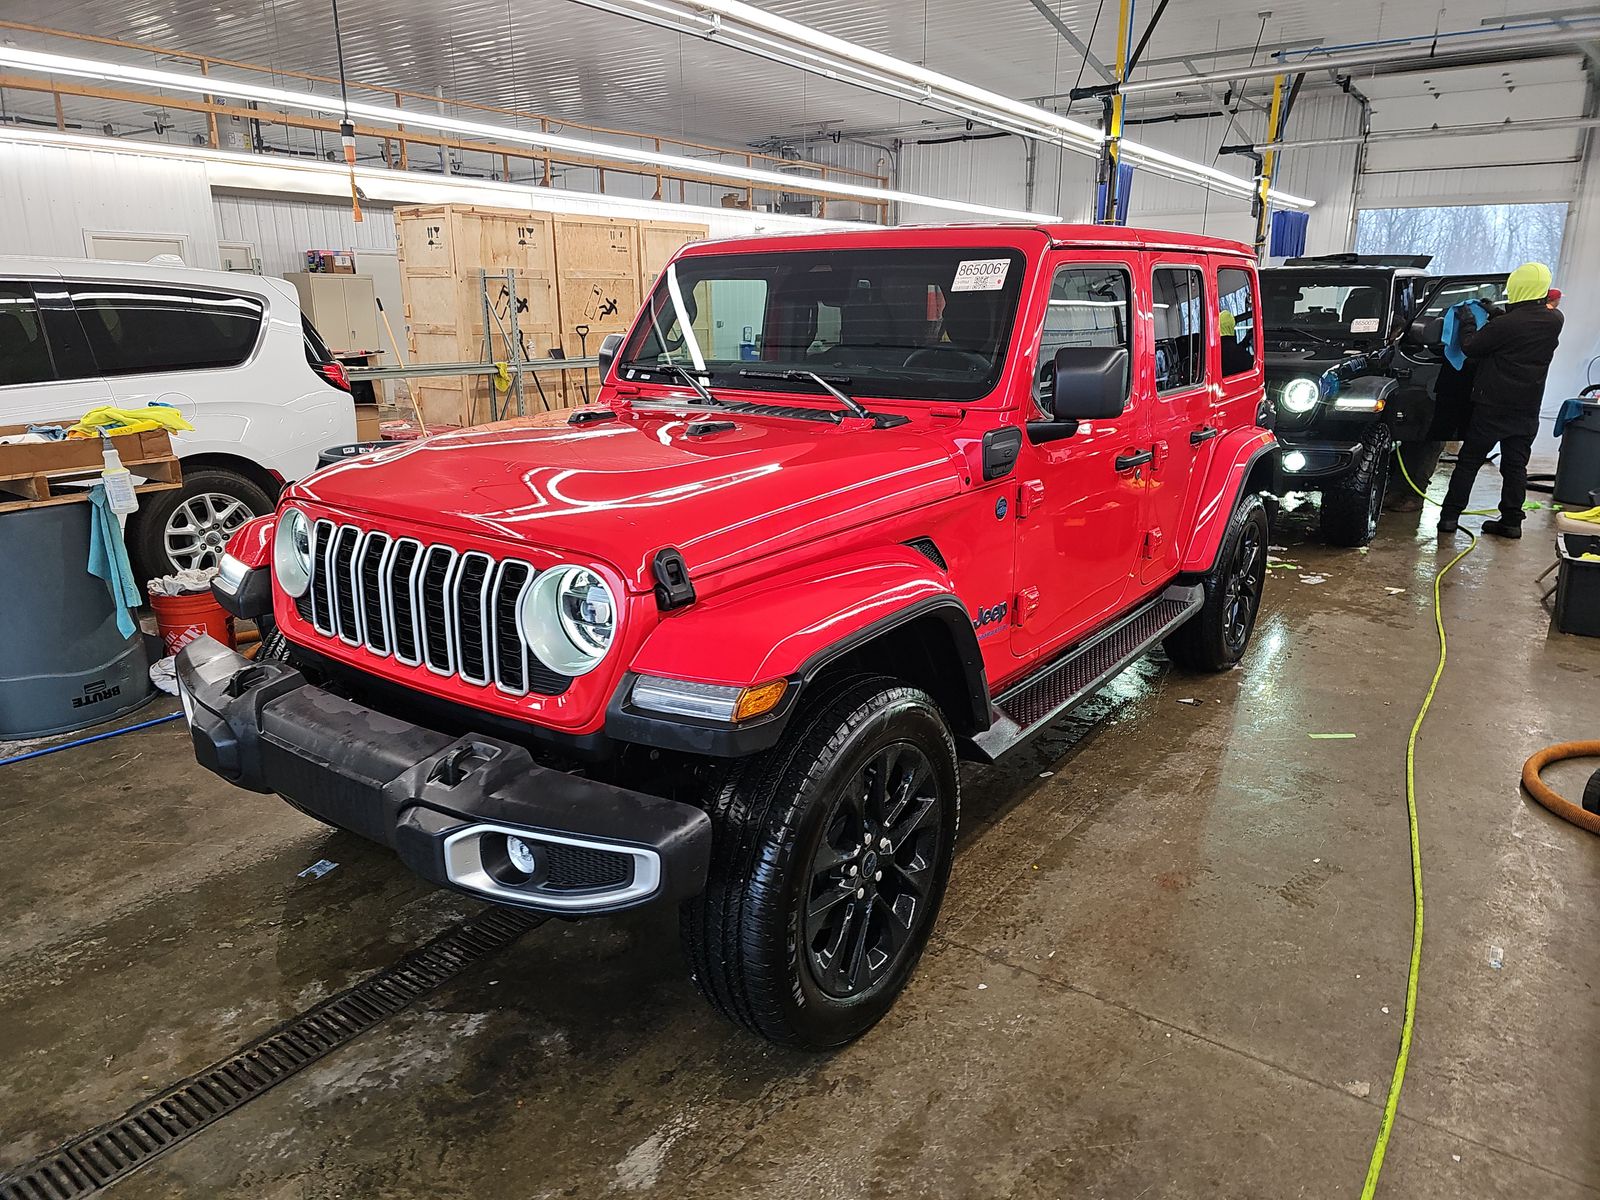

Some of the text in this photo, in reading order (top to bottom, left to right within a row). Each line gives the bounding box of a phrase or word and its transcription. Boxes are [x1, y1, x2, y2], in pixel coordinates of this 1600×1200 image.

[958, 262, 1009, 276] 8650067
[973, 601, 1007, 629] Jeep
[72, 685, 120, 709] BRUTE
